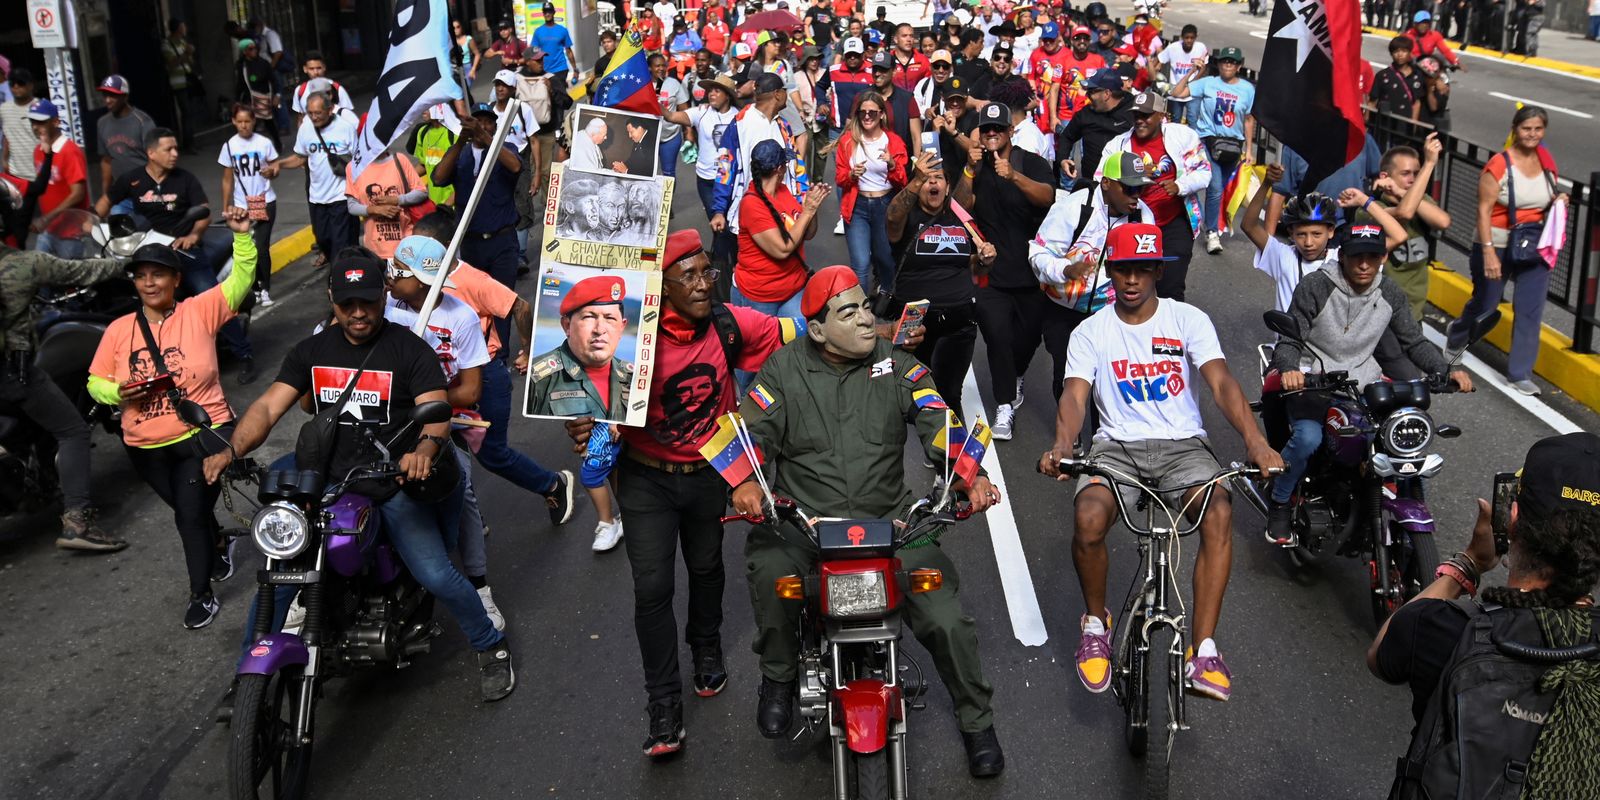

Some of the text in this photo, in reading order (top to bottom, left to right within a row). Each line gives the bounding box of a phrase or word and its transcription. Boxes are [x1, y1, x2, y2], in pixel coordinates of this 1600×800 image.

[546, 173, 560, 225] 2024
[571, 242, 641, 260] CHAVEZ VIVE
[554, 252, 562, 262] A
[624, 258, 643, 270] VOY
[645, 295, 658, 306] 70
[638, 334, 651, 389] 2024
[1111, 359, 1182, 380] Vamos
[322, 389, 378, 404] TUPMARO
